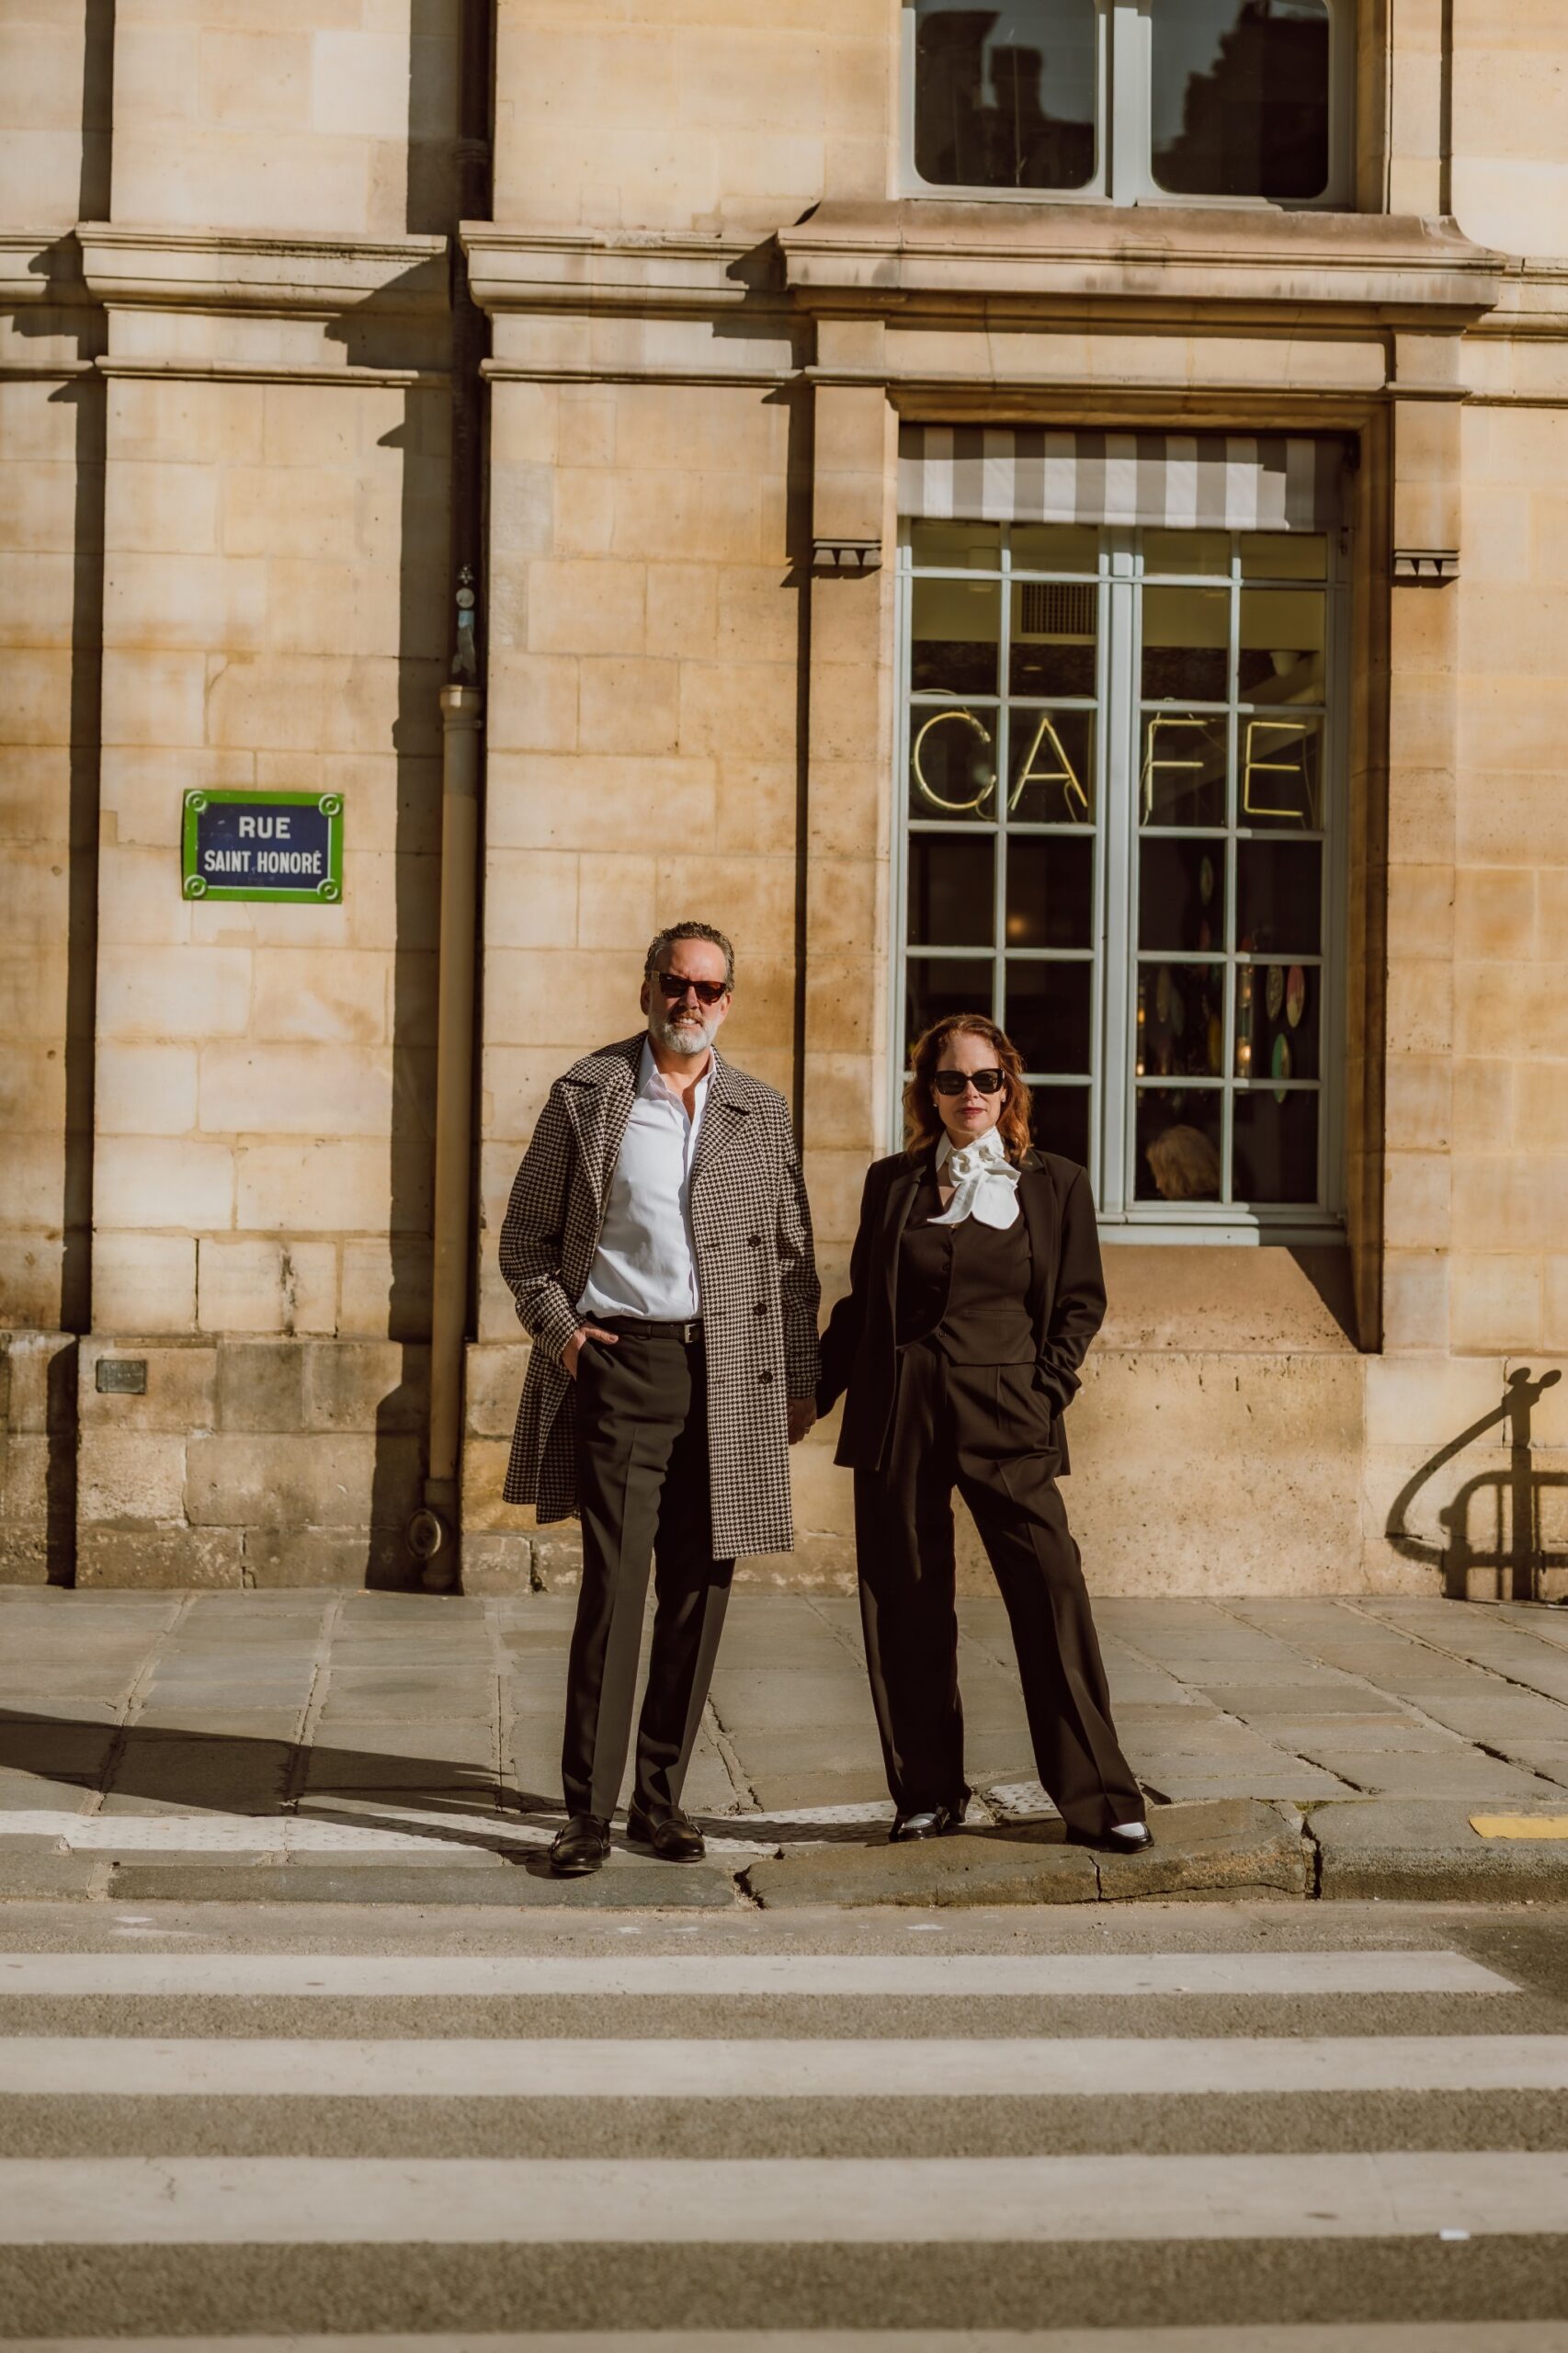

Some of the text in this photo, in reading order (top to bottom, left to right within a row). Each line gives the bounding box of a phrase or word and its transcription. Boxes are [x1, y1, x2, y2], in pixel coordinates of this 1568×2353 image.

[915, 711, 1306, 816] CAFE
[239, 816, 290, 838] RUE
[204, 849, 322, 874] SAINT HONORÉ
